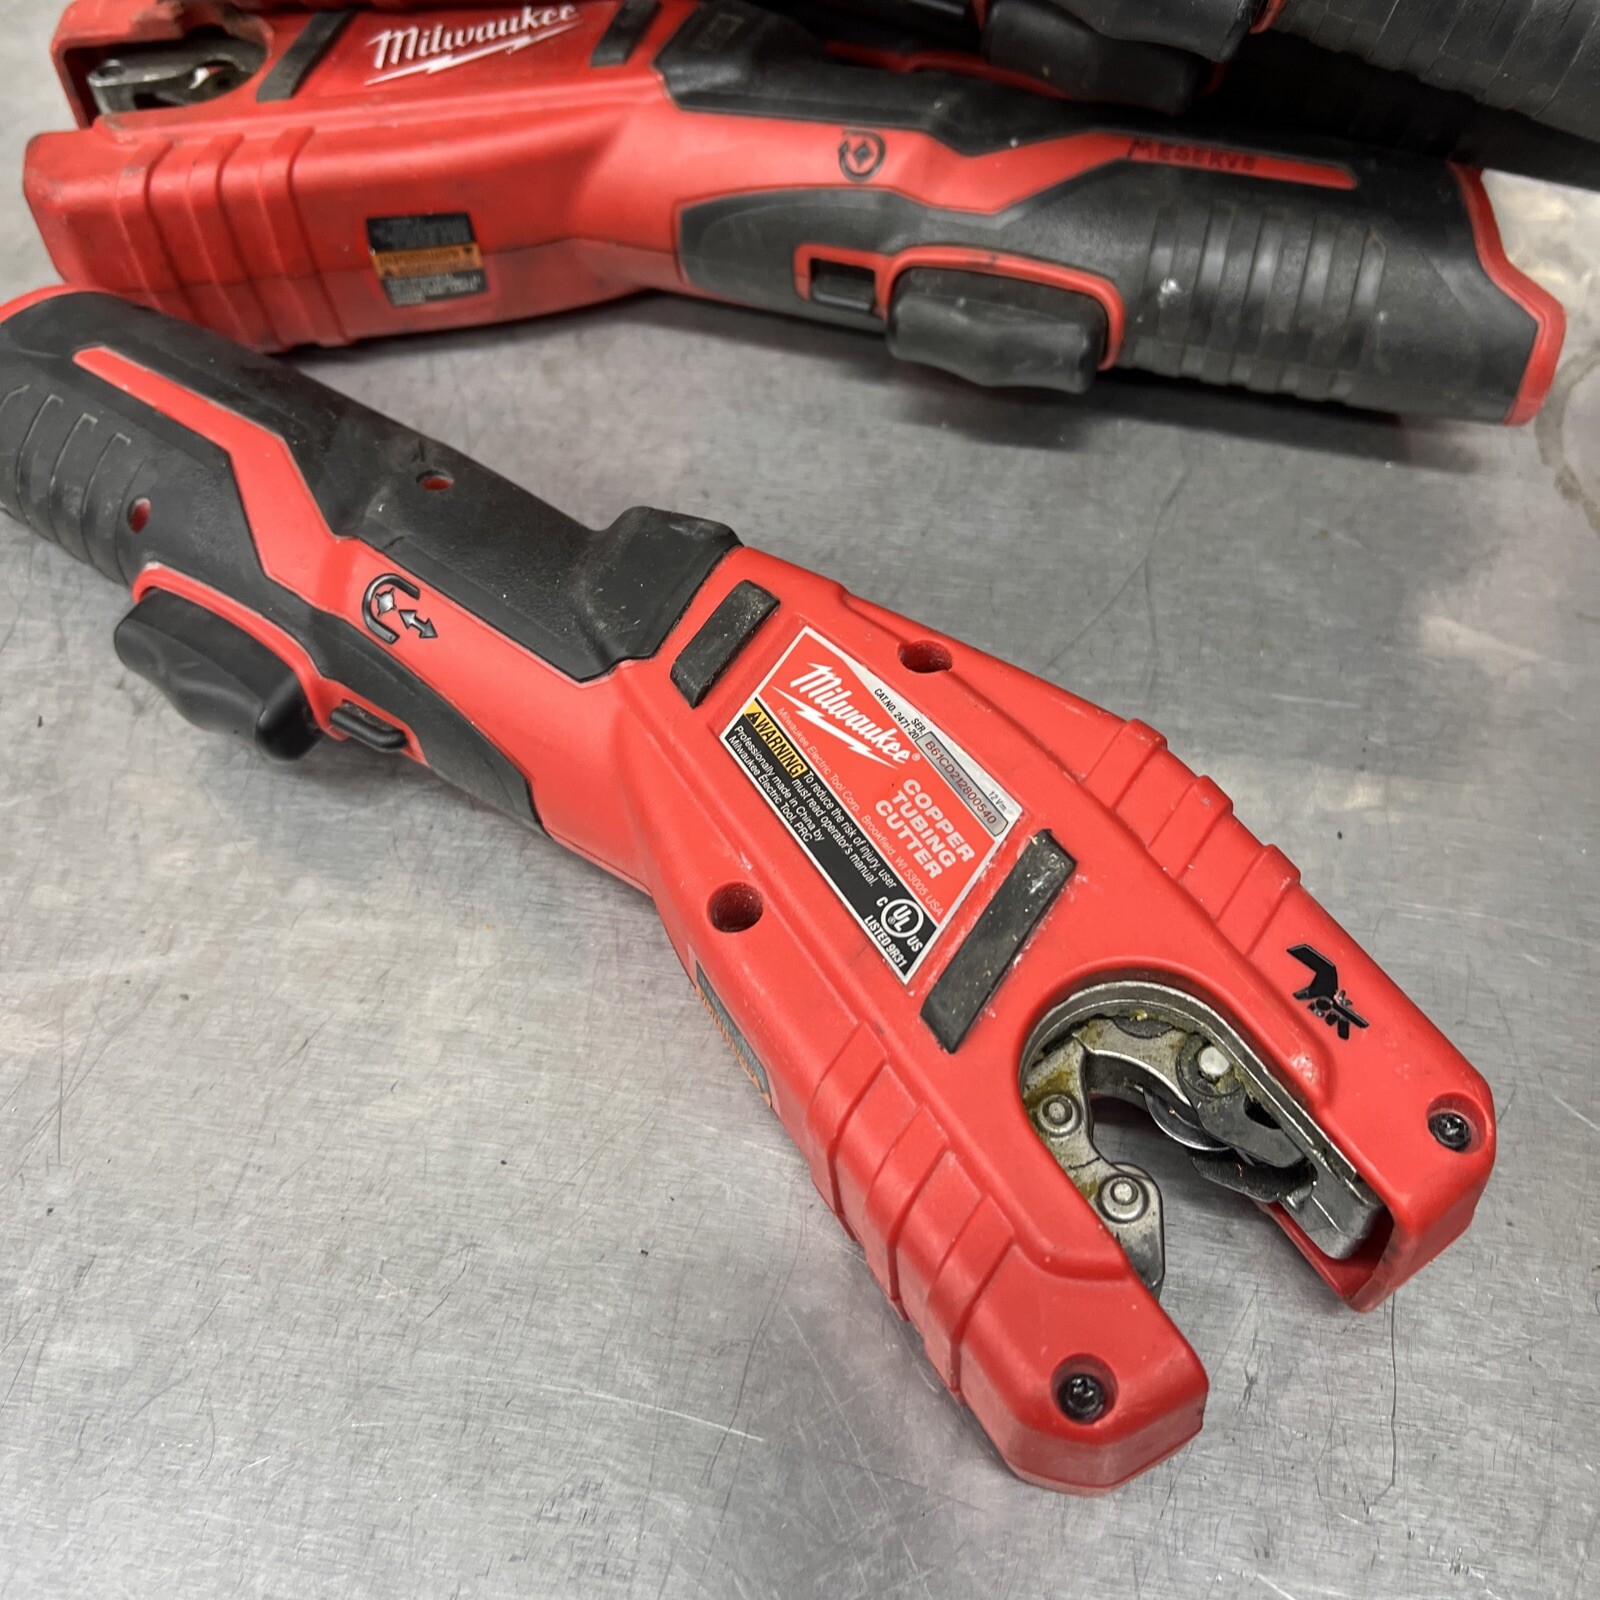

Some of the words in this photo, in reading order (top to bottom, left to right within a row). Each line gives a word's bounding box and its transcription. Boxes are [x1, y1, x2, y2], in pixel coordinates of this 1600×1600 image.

[366, 5, 576, 70] Milwaukee
[789, 663, 910, 762] Milwaukee
[873, 686, 897, 713] CAT.NO.
[893, 710, 920, 740] 2471-20
[910, 716, 926, 734] SER.
[754, 716, 805, 776] WARNING
[728, 734, 760, 776] Milwaukee
[757, 772, 782, 805] Electric
[779, 801, 797, 823] Tool,
[793, 820, 813, 843] PRC
[733, 724, 776, 777] Professionally
[771, 774, 793, 800] made
[788, 795, 798, 808] in
[794, 803, 816, 831] China
[812, 826, 825, 842] by
[803, 769, 814, 784] To
[809, 780, 833, 811] reduce
[924, 739, 997, 825] B61CD212800540
[776, 705, 810, 748] Milwaukee
[806, 743, 832, 776] Electric
[829, 772, 846, 792] Tool
[894, 855, 906, 870] WI
[925, 895, 944, 917] USA
[790, 778, 811, 800] must
[805, 796, 826, 819] read
[818, 816, 852, 855] operator's
[849, 852, 877, 887] manual.
[830, 806, 844, 825] the
[840, 821, 857, 839] risk
[874, 800, 942, 879] CUTTER
[890, 788, 957, 867] TUBING
[904, 778, 976, 862] COPPER
[852, 836, 866, 847] of
[858, 843, 880, 872] injury,
[877, 868, 897, 889] user
[863, 913, 892, 947] LISTED
